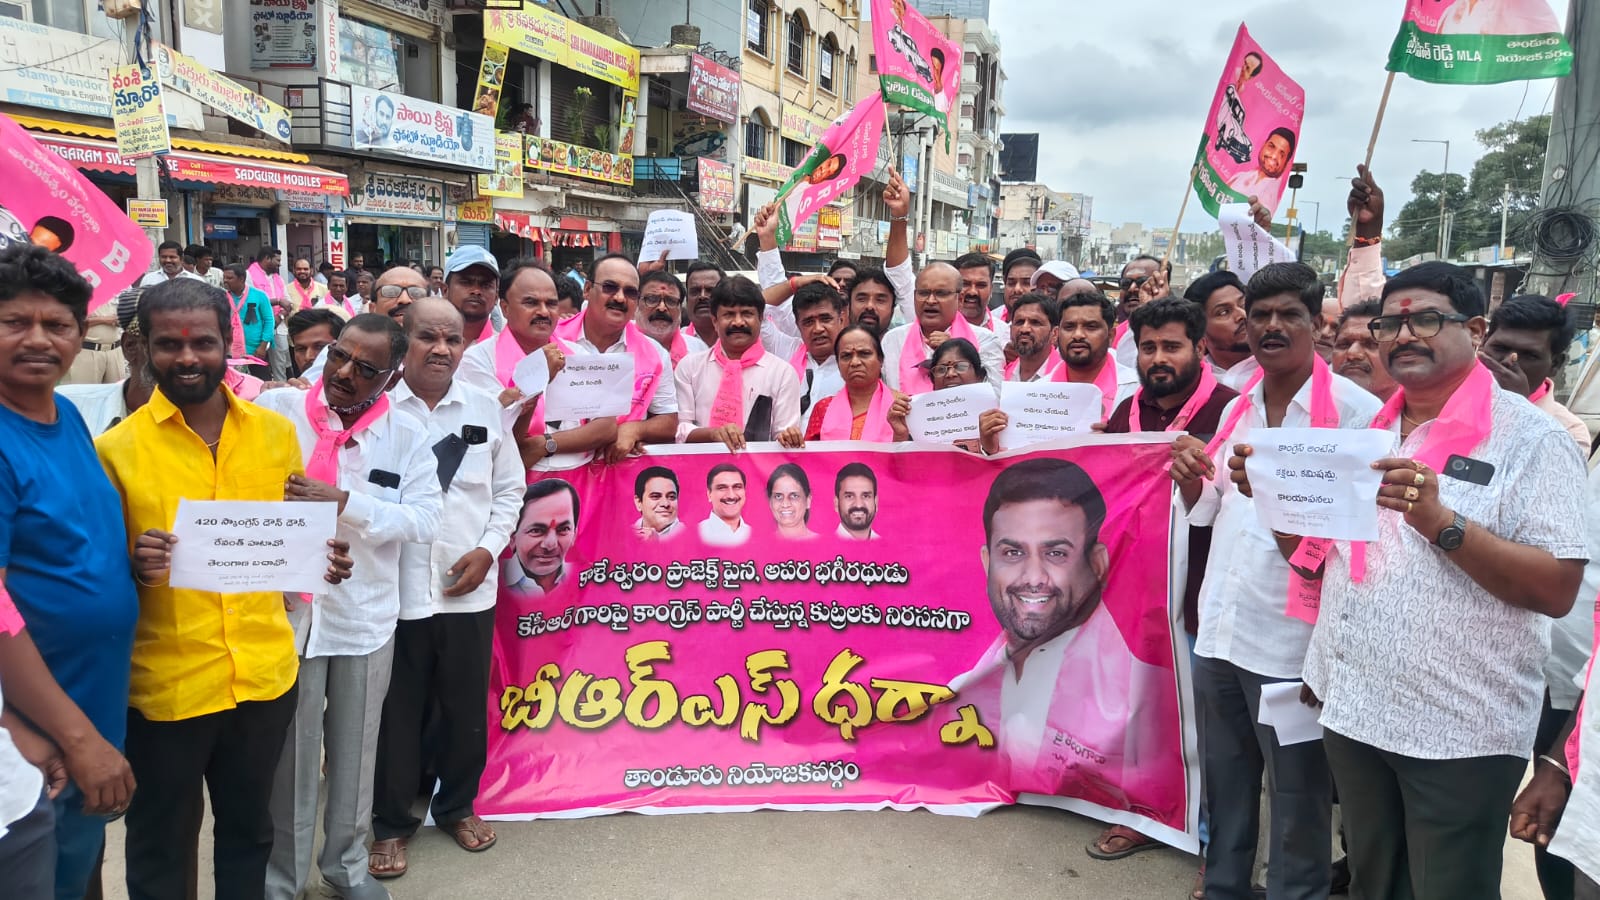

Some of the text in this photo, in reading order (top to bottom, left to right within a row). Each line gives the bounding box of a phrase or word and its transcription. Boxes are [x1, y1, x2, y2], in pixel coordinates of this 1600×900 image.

[328, 12, 337, 74] XEROX
[1457, 51, 1482, 62] MLA
[18, 69, 102, 90] Stamp Vendor
[43, 84, 107, 102] Telugu & English
[397, 103, 432, 125] సాయి
[278, 123, 290, 135] Jio
[393, 128, 460, 153] ఫోటో స్టూడియో
[234, 168, 281, 184] SADGURU
[284, 173, 321, 189] MOBILES
[564, 203, 604, 217] uality
[1278, 443, 1305, 454] కాంగ్రెస్
[1277, 493, 1334, 504] కాలయాపనలు
[195, 518, 218, 526] 420
[262, 517, 284, 527] డౌన్
[213, 538, 244, 547] రేవంత్
[207, 559, 249, 567] తెలంగాణ
[578, 555, 909, 590] కాళేశ్వరం ప్రాజెక్ట్ పైన, అపర భగీరథుడు
[517, 596, 971, 637] కేసీఆర్ గారిపై కాంగ్రెస్ పార్టీ చేస్తున్న కుట్రలకు నిరసనగా
[500, 640, 996, 748] బీఆర్ఎస్ ధర్నా
[623, 760, 861, 791] తాండూరు నియోజకవర్గం
